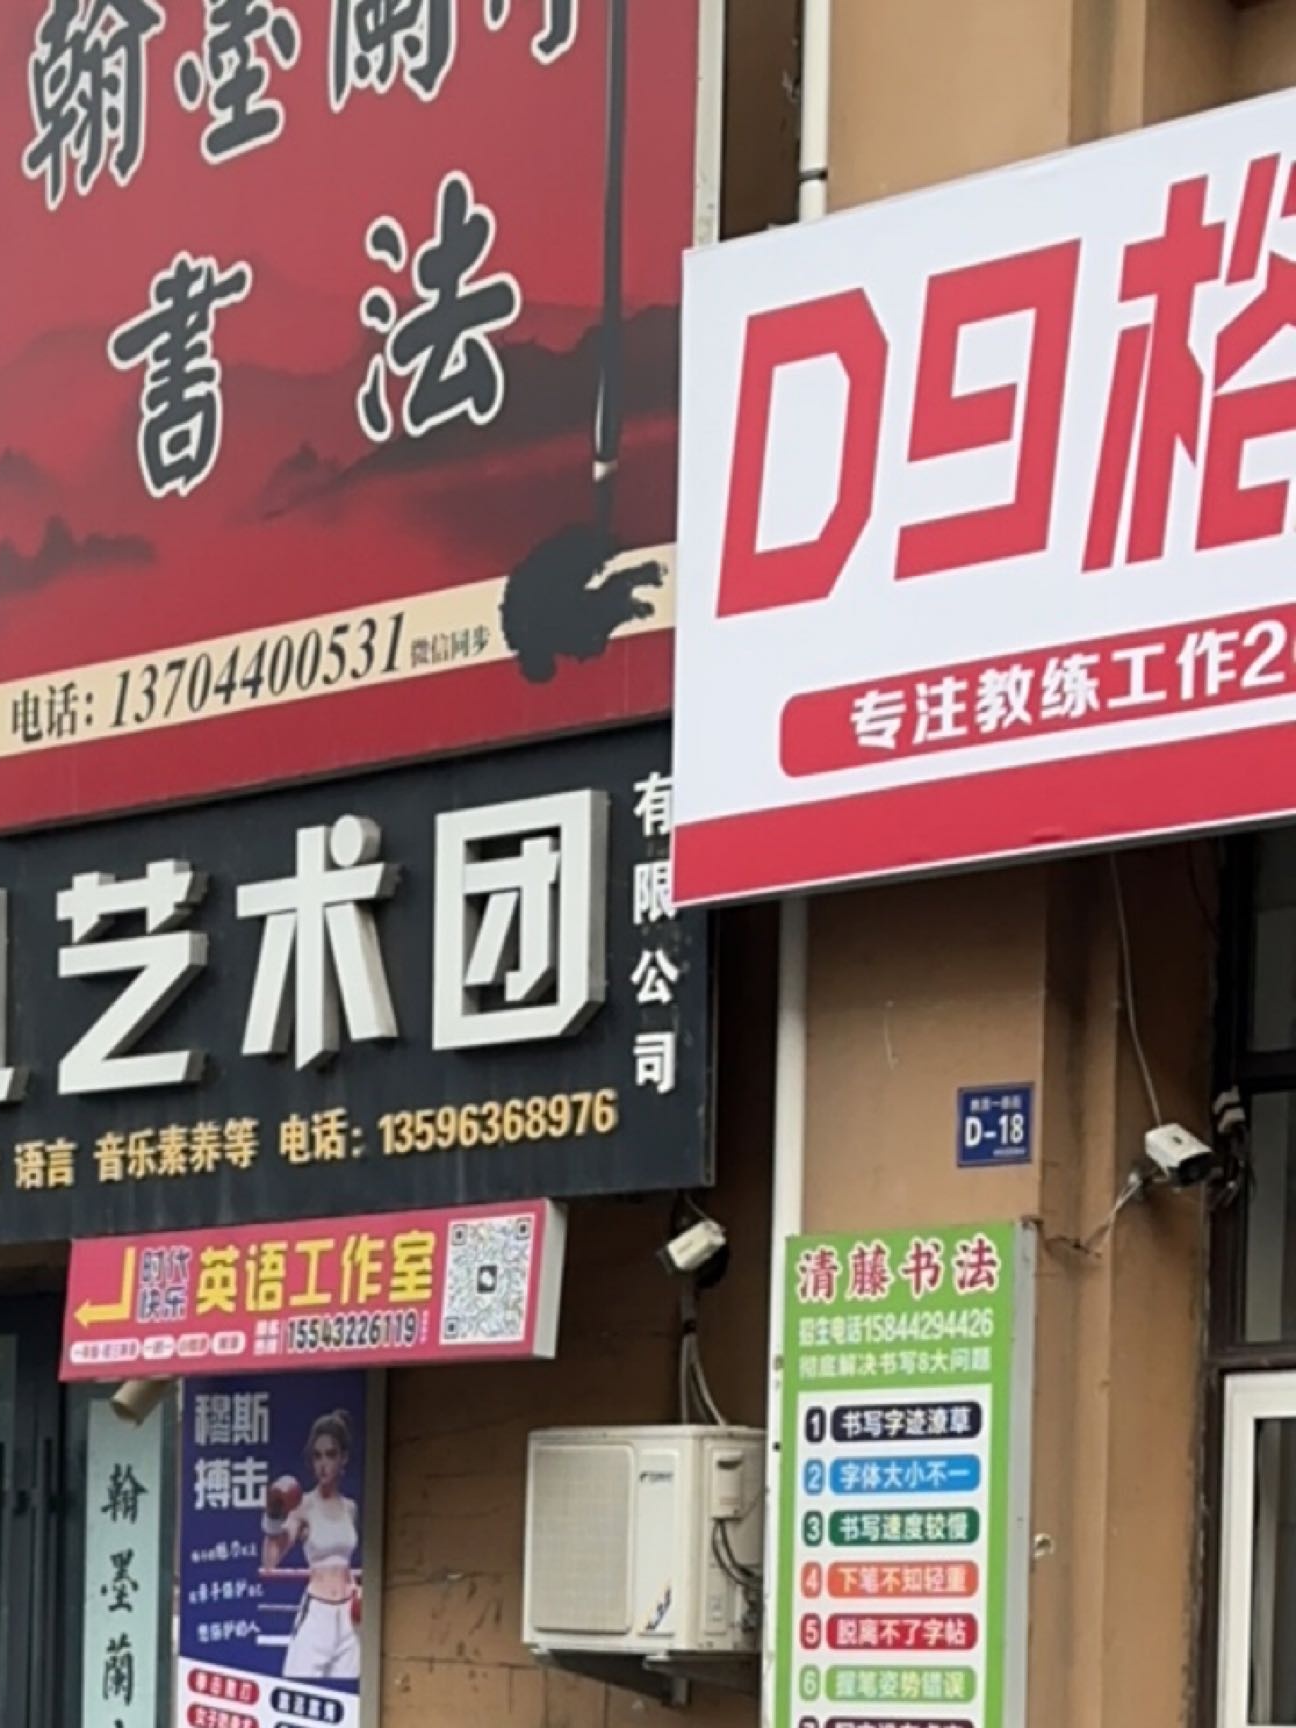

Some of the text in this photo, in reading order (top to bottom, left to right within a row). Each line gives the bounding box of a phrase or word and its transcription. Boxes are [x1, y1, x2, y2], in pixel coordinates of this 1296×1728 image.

[410, 626, 491, 670] 微信同步
[851, 617, 1296, 752] 专注教练工作2
[632, 771, 679, 1094] 有限公司
[965, 1113, 1024, 1146] D-18
[14, 1137, 78, 1191] 语言
[94, 1118, 260, 1184] 音乐素养等
[194, 1230, 436, 1316] 英语工作室
[797, 1232, 1002, 1302] 清藤书法
[810, 1407, 972, 1438] 1 书写字迹潦草
[194, 1456, 269, 1511] 搏击
[807, 1461, 971, 1490] 2 字体大小不一
[806, 1512, 969, 1542] 3 书写速度较慢
[804, 1566, 967, 1594] 4 下笔不知轻重
[804, 1618, 819, 1644] 5
[803, 1670, 817, 1696] 6
